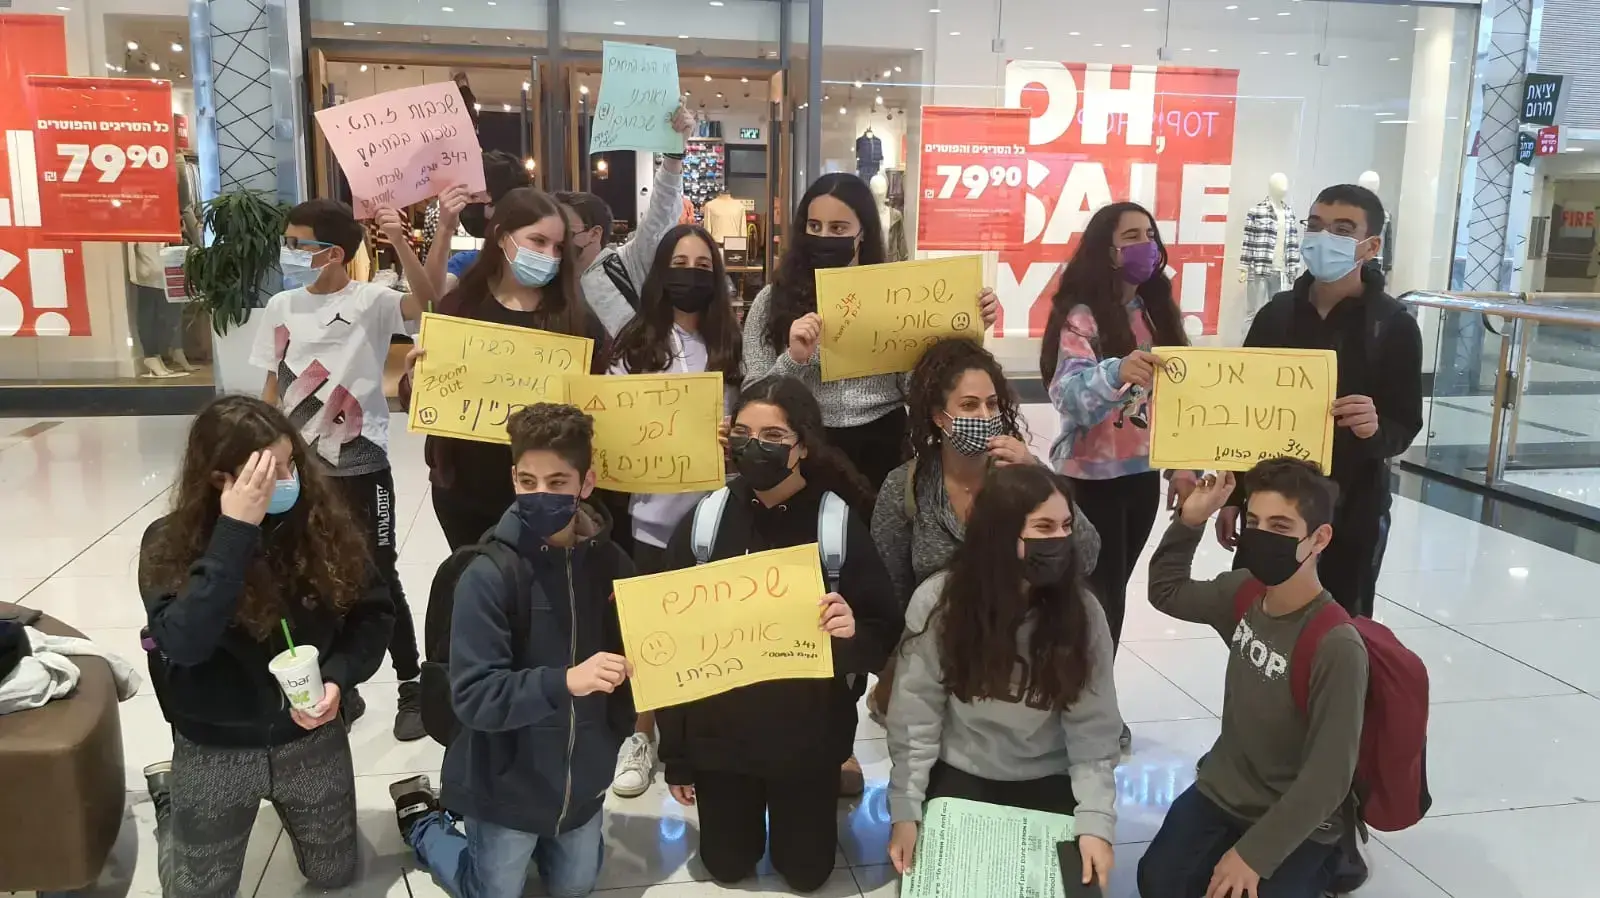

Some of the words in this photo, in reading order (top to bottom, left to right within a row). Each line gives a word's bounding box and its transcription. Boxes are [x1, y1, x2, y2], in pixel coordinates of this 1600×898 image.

[1527, 83, 1556, 100] יציאת
[407, 94, 459, 121] שכבות
[1005, 59, 1166, 154] OH,
[1525, 101, 1553, 118] חירום
[37, 119, 97, 130] והפוטרים
[100, 121, 152, 132] הסריגים
[153, 120, 169, 132] כל
[440, 151, 467, 166] 347
[924, 143, 970, 154] והפוטרים
[971, 144, 1012, 155] הסריגים
[1013, 144, 1026, 155] כל
[1562, 210, 1595, 228] FIRE
[886, 278, 954, 304] שכחו
[998, 262, 1208, 338] Y!
[892, 310, 943, 333] אותי
[462, 332, 516, 360] השרון
[534, 346, 572, 370] הוד
[1200, 362, 1245, 389] אני
[1276, 365, 1314, 390] גם
[617, 381, 689, 409] ילדים
[631, 410, 680, 446] לפני
[1171, 397, 1297, 437] חשובה!
[1282, 438, 1311, 461] 347
[617, 455, 691, 483] קניונים
[376, 484, 391, 547] BROOKLYN
[661, 566, 790, 615] שכחתם
[697, 621, 785, 664] אותנו
[793, 639, 816, 650] 347
[675, 657, 744, 688] בבית!
